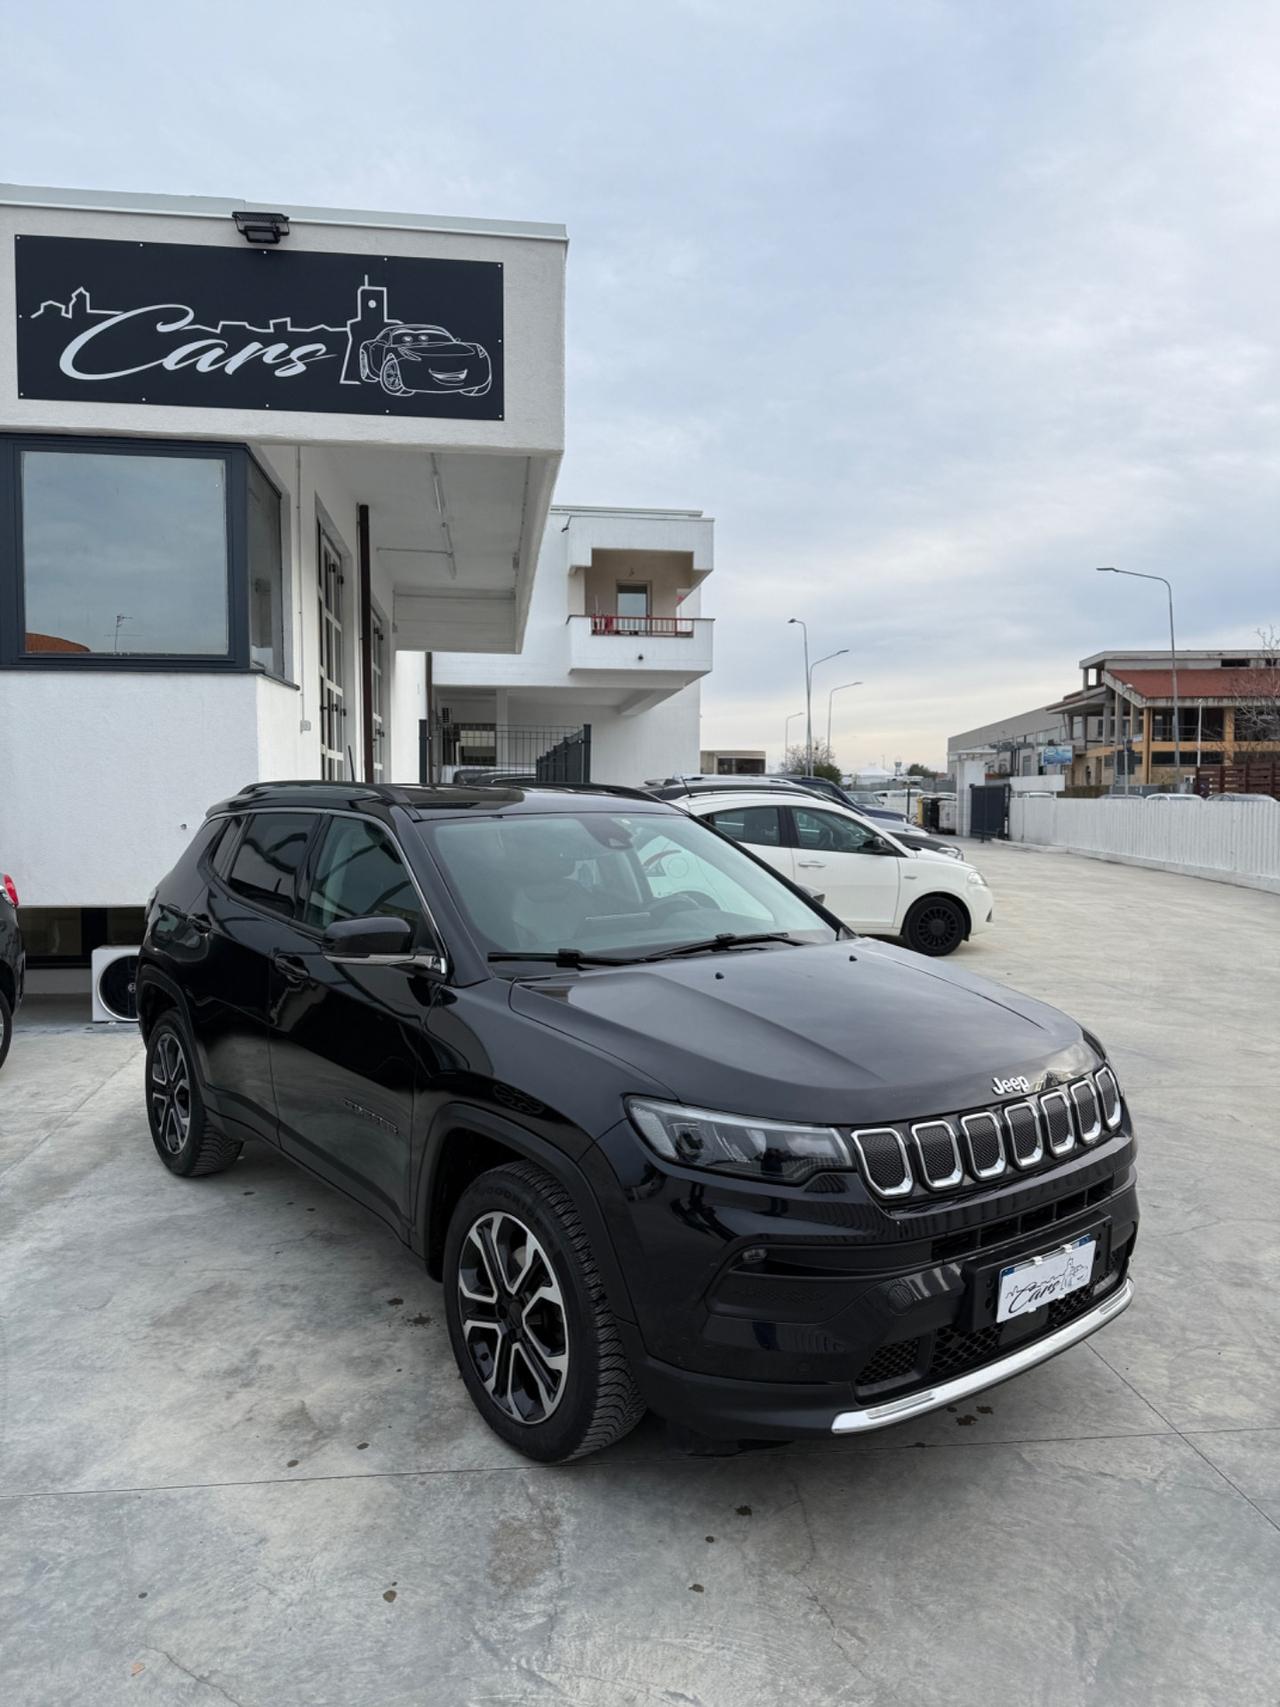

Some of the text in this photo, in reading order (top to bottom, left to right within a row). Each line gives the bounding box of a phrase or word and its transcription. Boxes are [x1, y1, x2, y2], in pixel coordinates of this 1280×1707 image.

[59, 304, 338, 381] Cars
[992, 1074, 1031, 1095] Jeep
[1008, 1281, 1060, 1314] Cars
